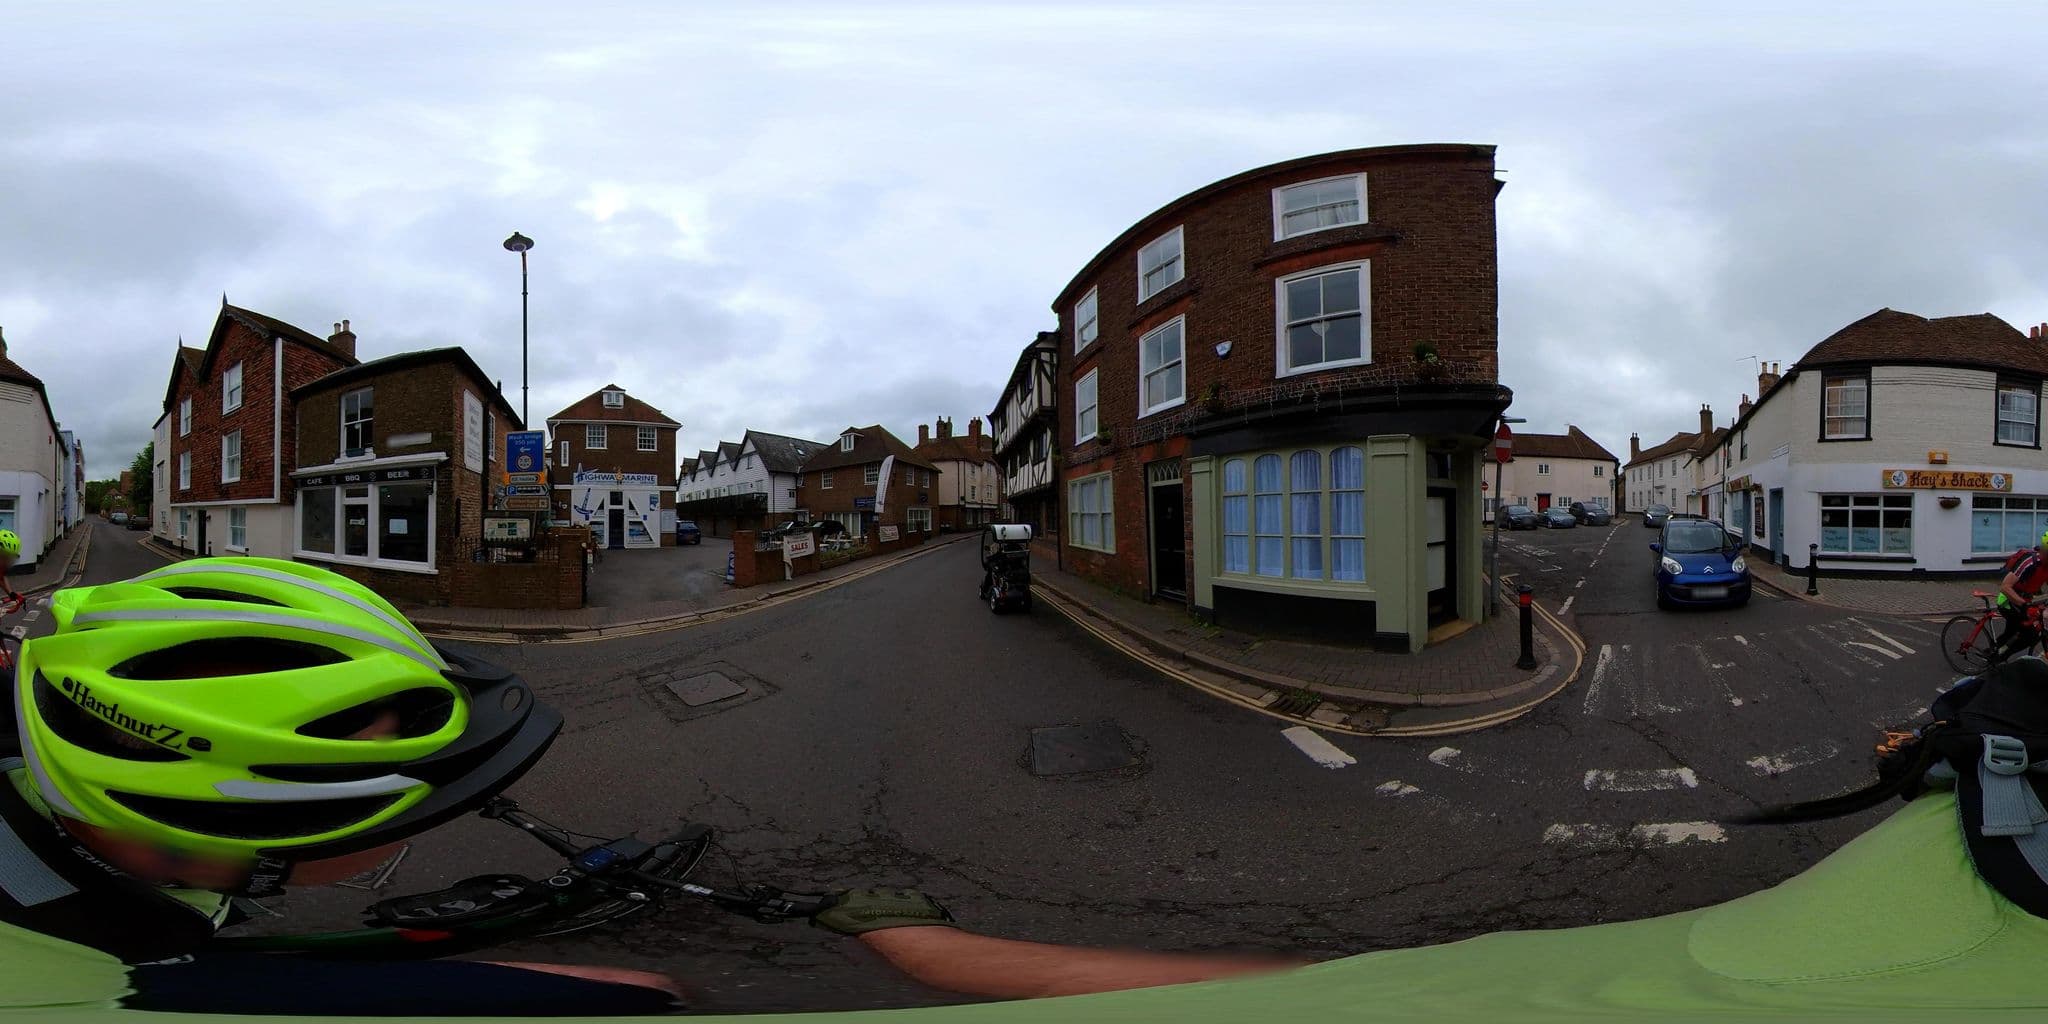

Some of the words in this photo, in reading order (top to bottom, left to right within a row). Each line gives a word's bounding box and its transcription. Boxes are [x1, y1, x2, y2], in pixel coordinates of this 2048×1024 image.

[345, 474, 360, 482] BBQ
[387, 470, 410, 479] BEER
[622, 474, 656, 482] MARINE
[1909, 471, 1947, 489] Hay's
[1950, 472, 1990, 488] Shack
[790, 541, 809, 552] SALES
[72, 680, 185, 749] HardnutZ
